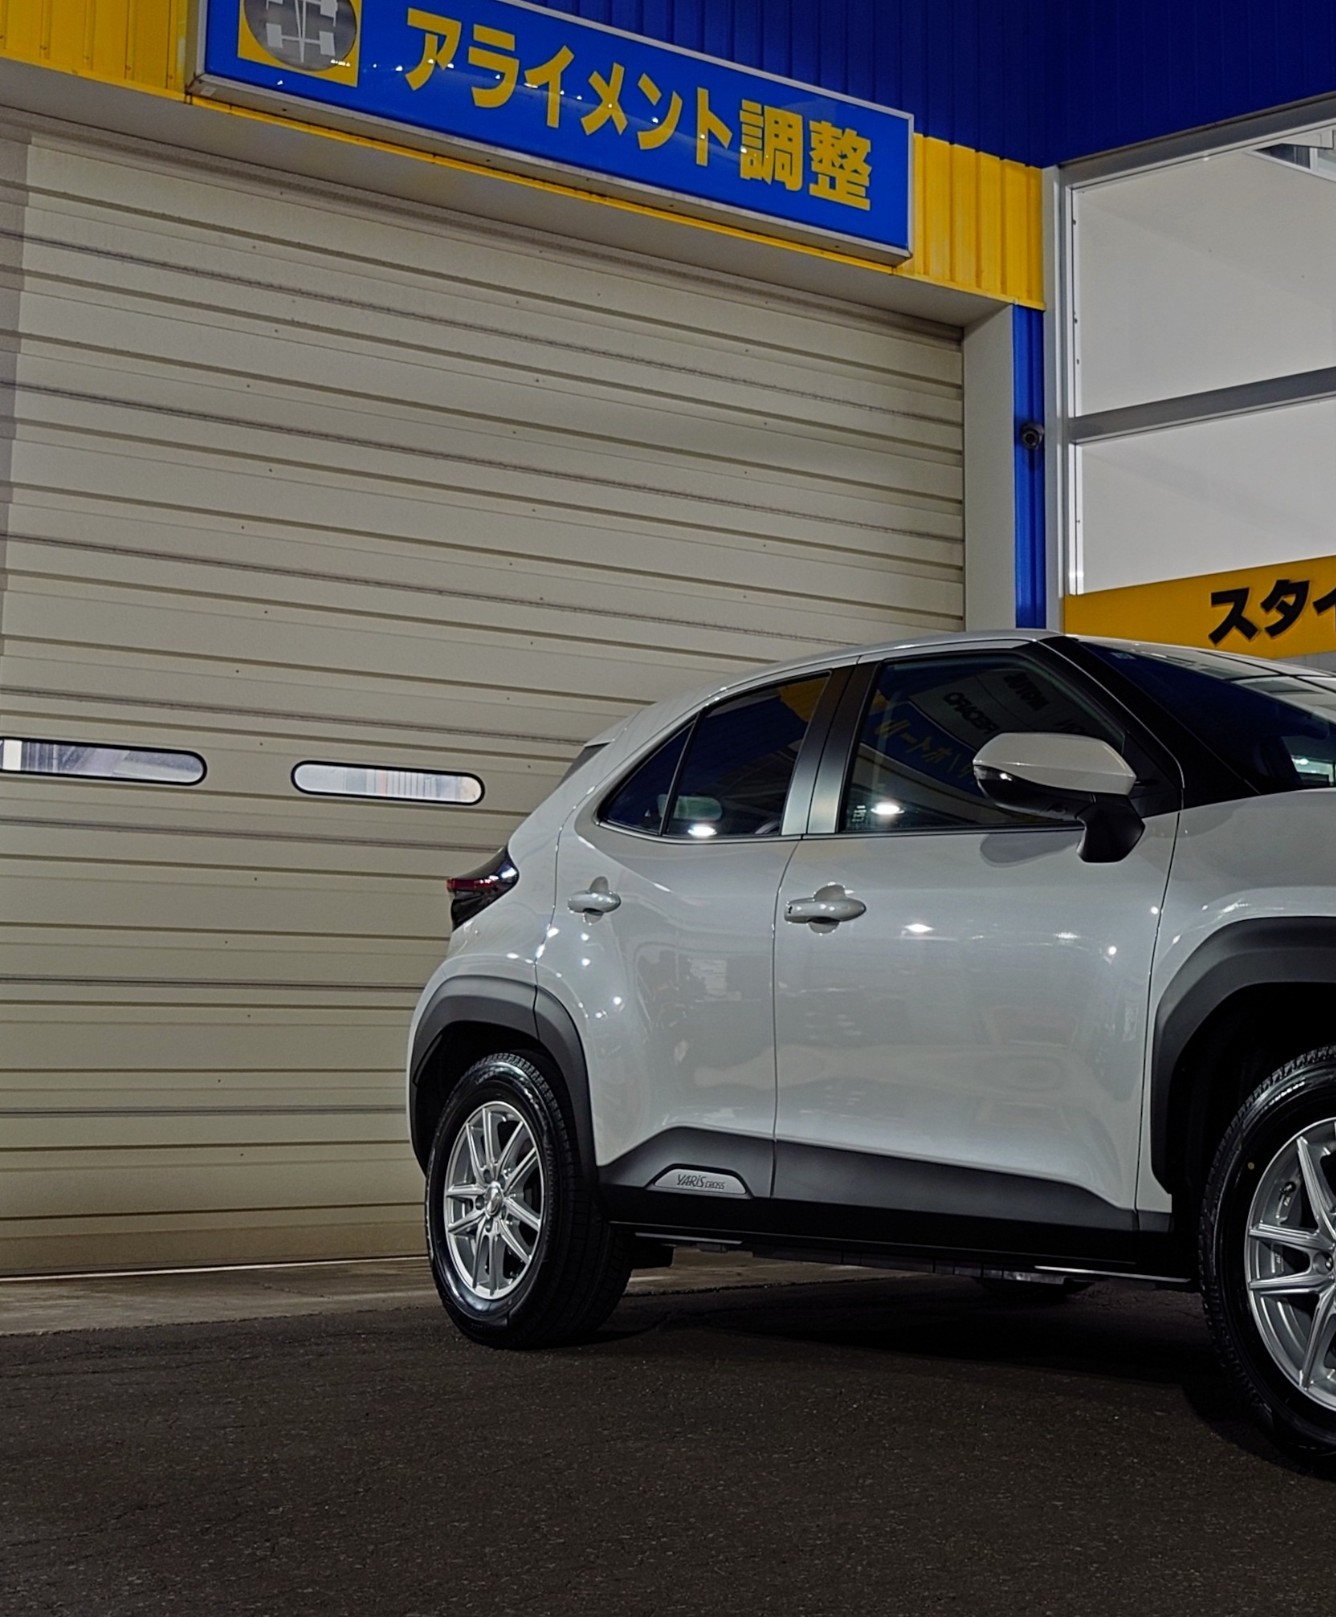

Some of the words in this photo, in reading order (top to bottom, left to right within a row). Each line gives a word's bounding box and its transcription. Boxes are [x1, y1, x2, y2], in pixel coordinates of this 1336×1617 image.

[404, 7, 873, 211] アライメント調整
